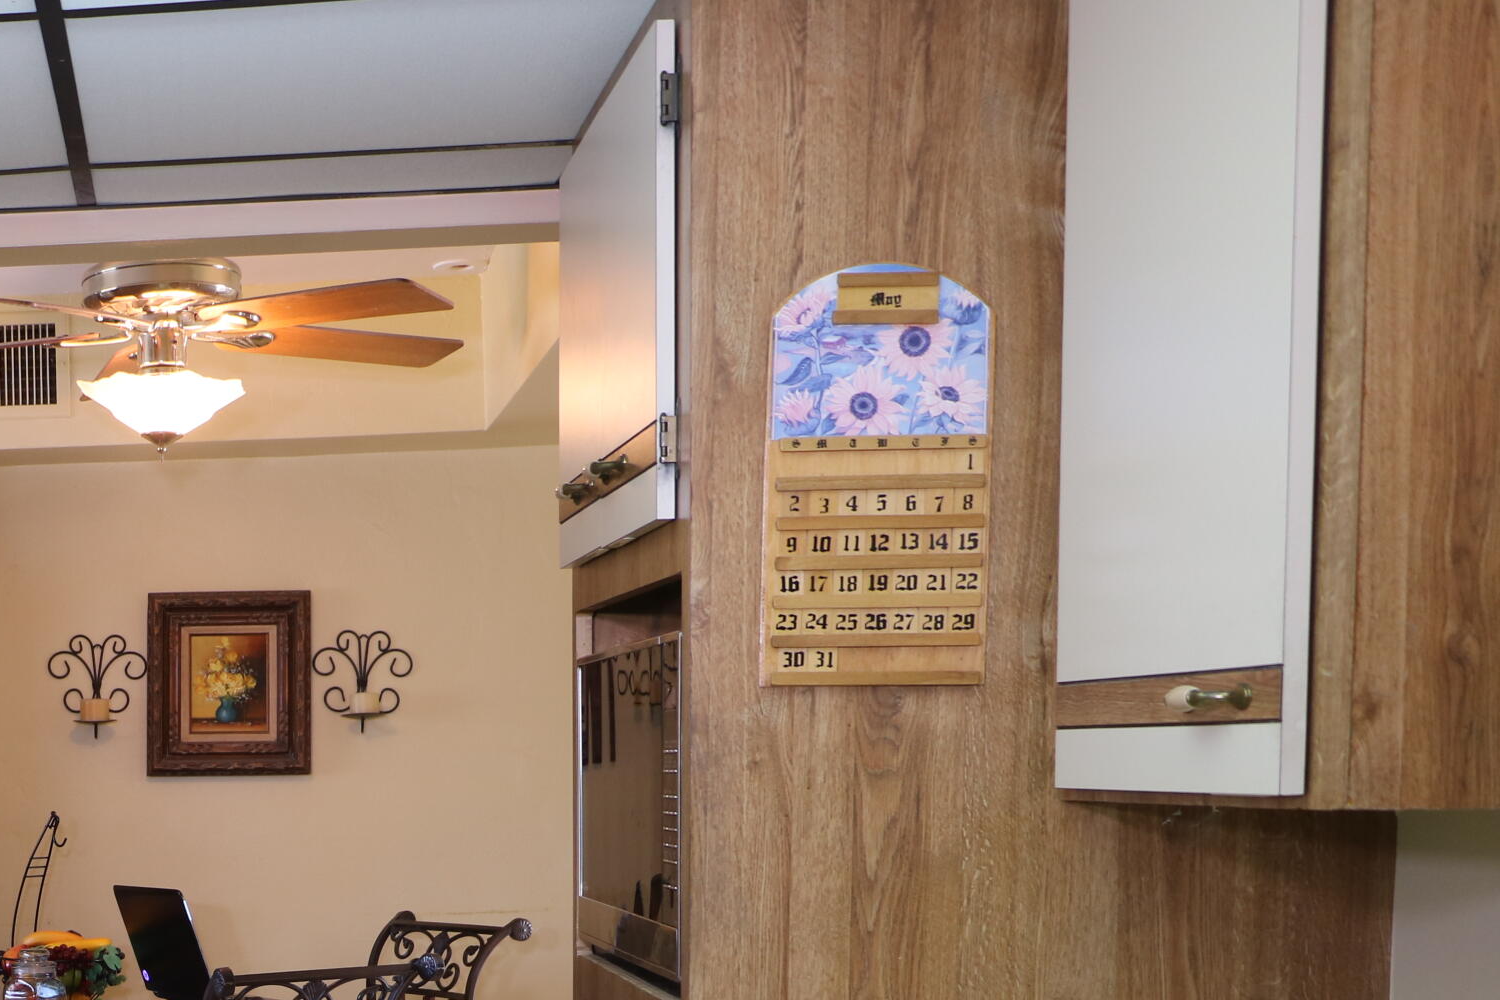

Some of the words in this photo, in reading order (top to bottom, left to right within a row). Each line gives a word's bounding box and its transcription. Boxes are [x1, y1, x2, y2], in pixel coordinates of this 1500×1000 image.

[870, 292, 902, 308] May
[967, 453, 973, 470] 1
[789, 495, 800, 512] 2
[819, 497, 829, 514] 3
[845, 495, 858, 512] 4
[876, 494, 887, 511] 5
[905, 494, 916, 511] 6
[934, 496, 945, 513] 7
[962, 493, 973, 511] 8
[786, 536, 797, 553] 9
[811, 535, 832, 553] 10
[843, 534, 860, 552] 11
[870, 534, 890, 552] 12
[900, 532, 920, 550] 13
[928, 532, 948, 550] 14
[958, 532, 979, 550] 15
[779, 575, 800, 593] 16
[809, 575, 828, 592] 17
[838, 575, 858, 593] 18
[867, 574, 889, 591] 19
[895, 574, 918, 591] 20
[926, 574, 946, 591] 21
[955, 572, 979, 590] 22
[775, 614, 798, 631] 23
[805, 613, 828, 630] 24
[835, 613, 858, 631] 25
[864, 613, 888, 631] 26
[893, 613, 915, 630] 27
[922, 614, 945, 631] 28
[951, 613, 976, 631] 29
[783, 651, 805, 668] 30
[816, 651, 834, 668] 31
